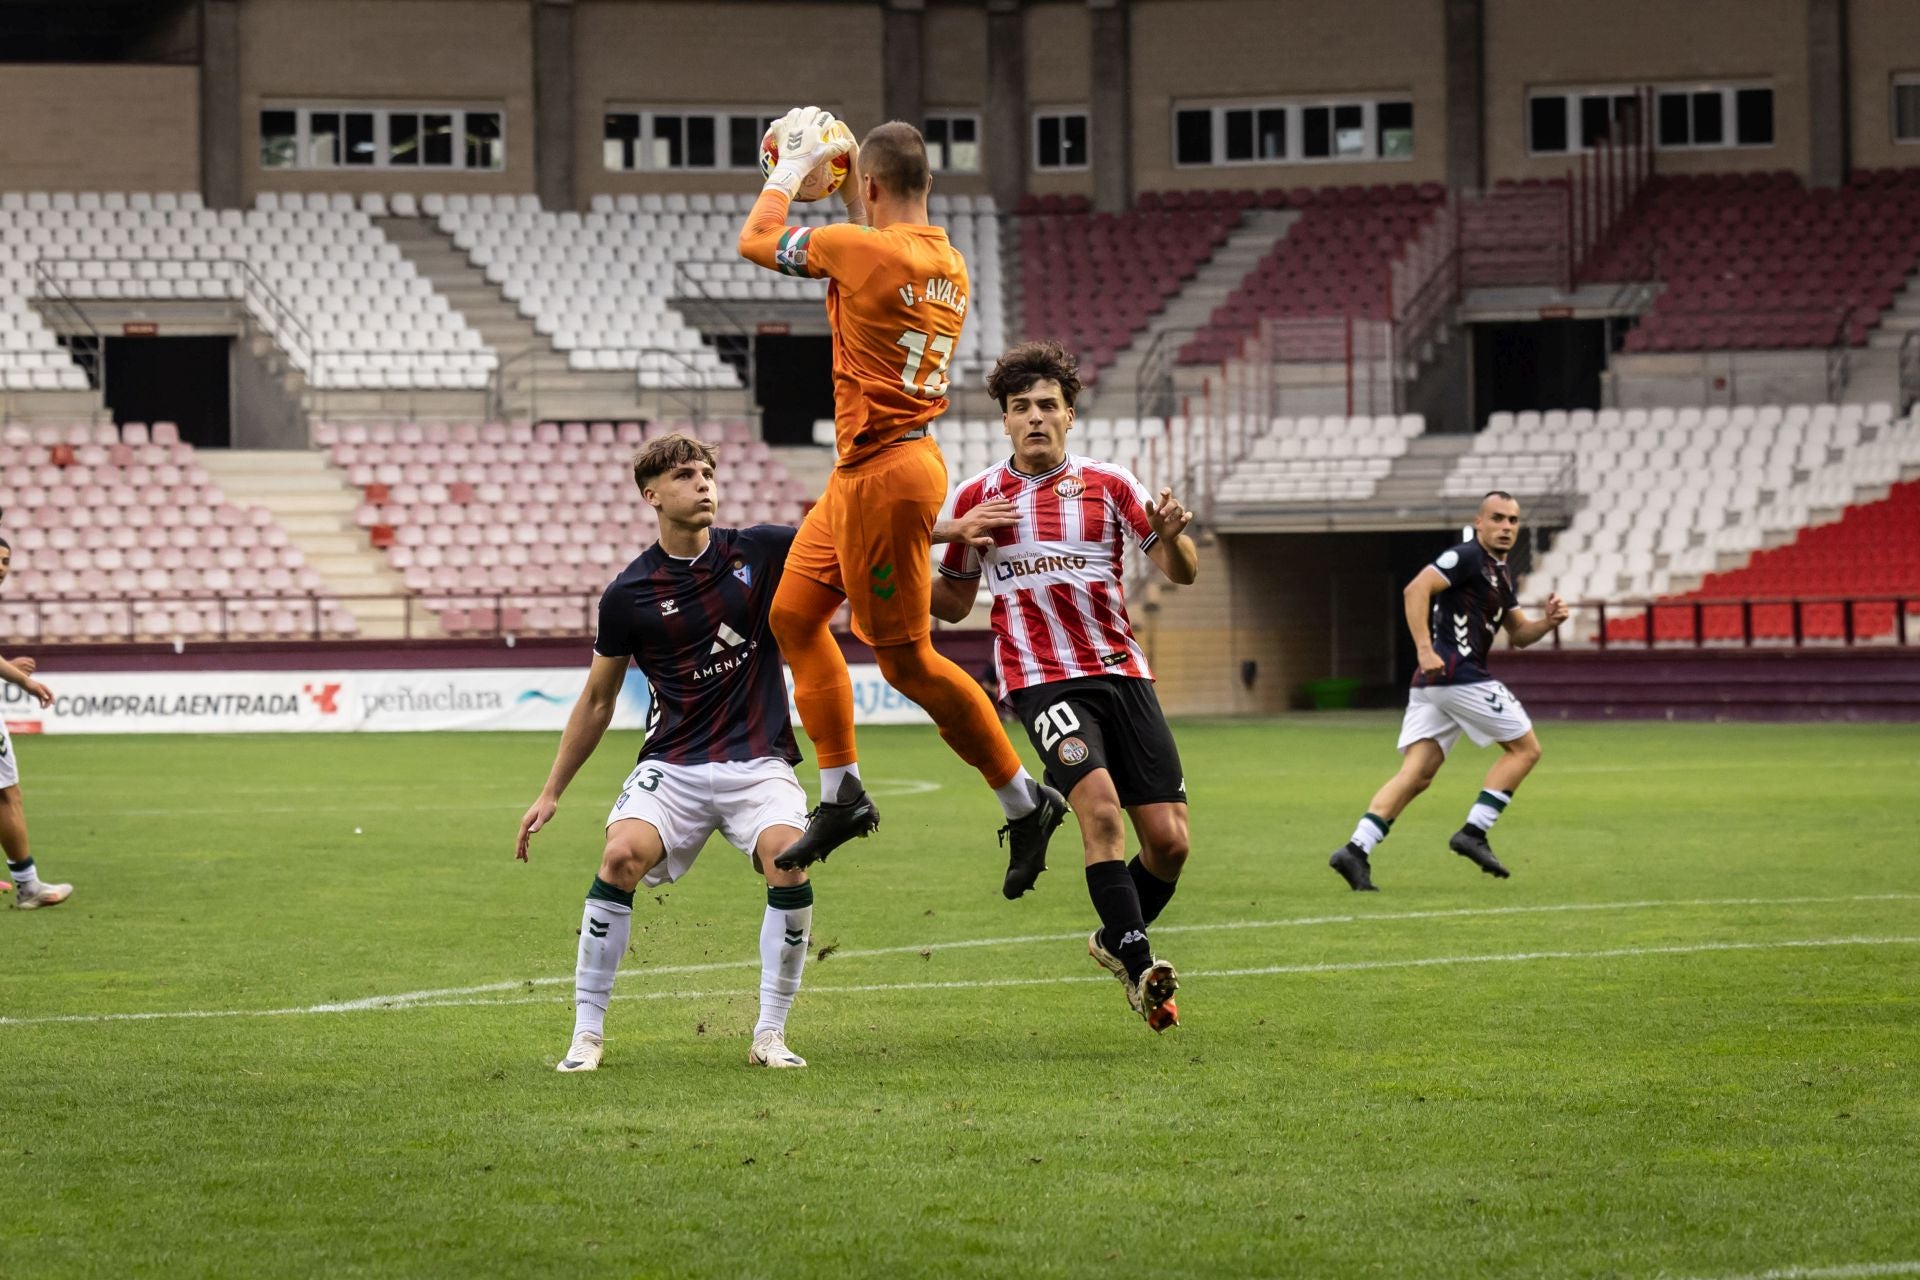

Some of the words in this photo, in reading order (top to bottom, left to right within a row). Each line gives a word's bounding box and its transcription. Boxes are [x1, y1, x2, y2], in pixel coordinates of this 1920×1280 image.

[1012, 555, 1087, 577] BLANCO
[53, 694, 299, 717] COMPRALAENTRADA
[361, 685, 502, 717] peñaclara
[1034, 700, 1081, 752] 20
